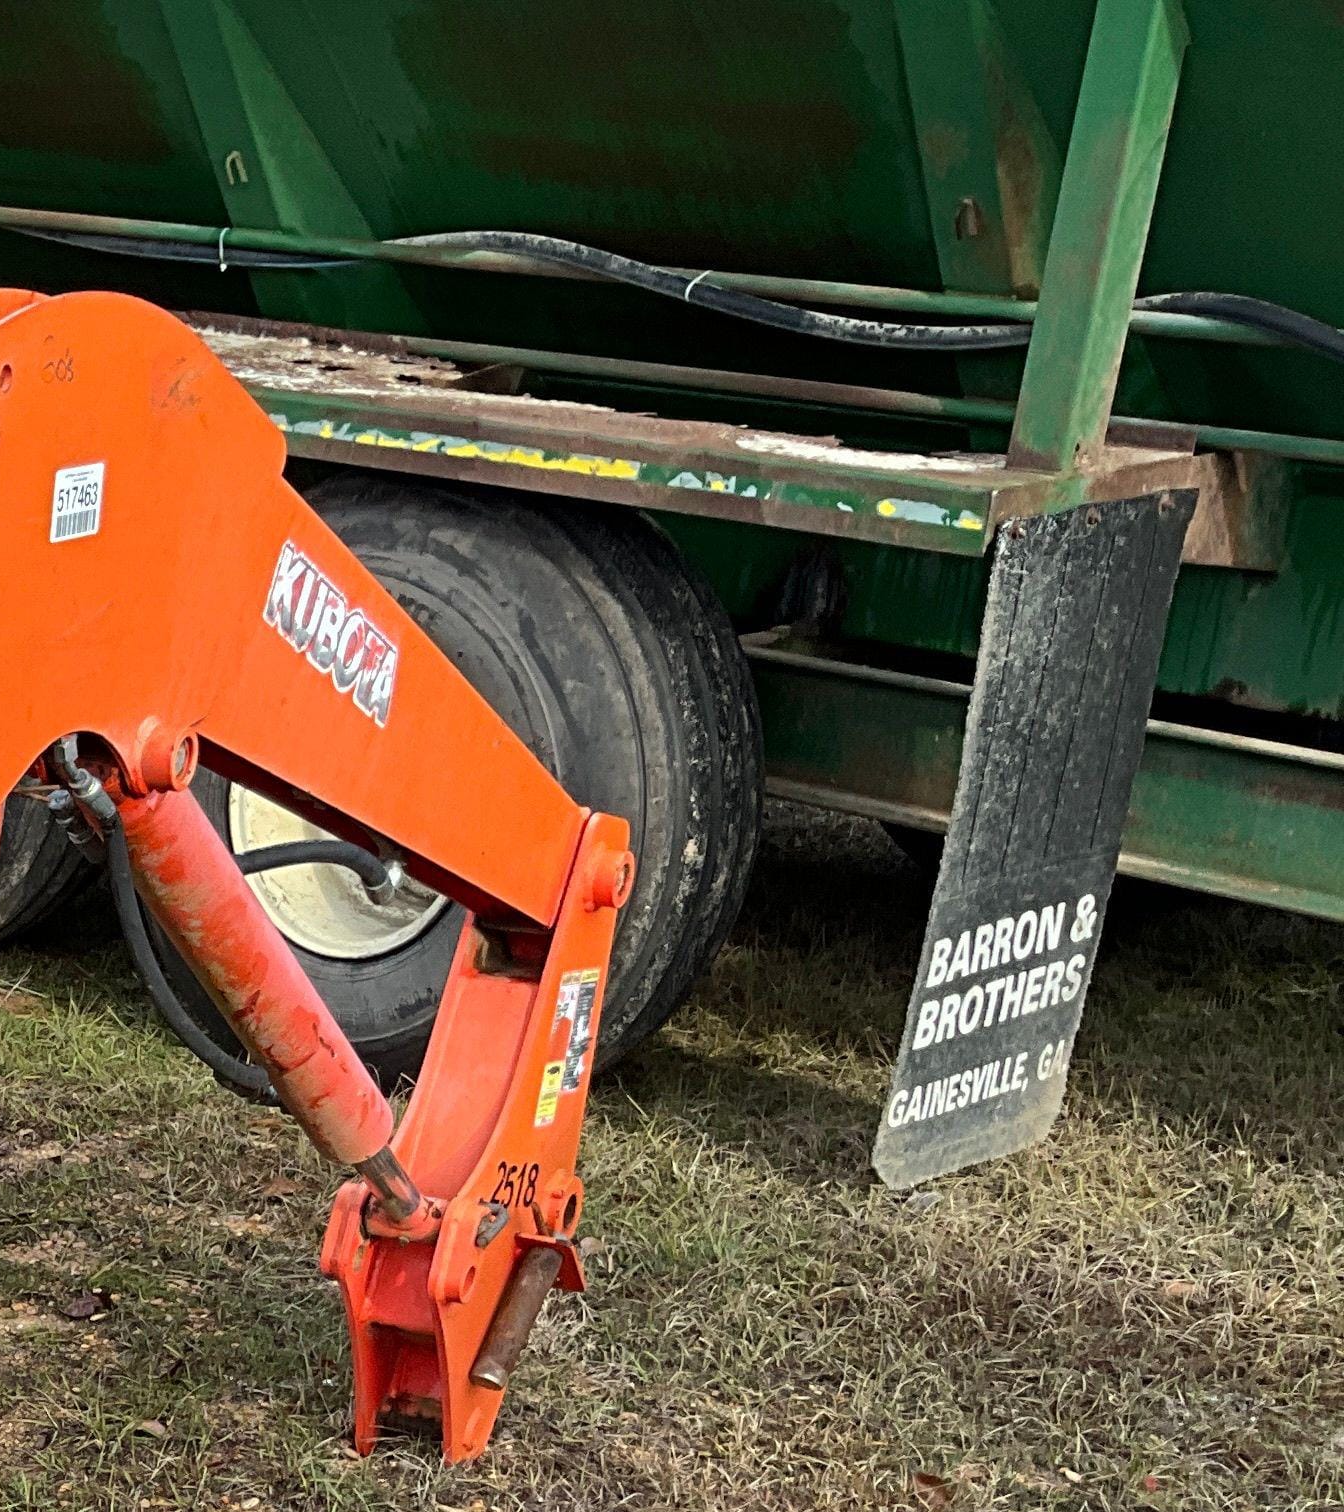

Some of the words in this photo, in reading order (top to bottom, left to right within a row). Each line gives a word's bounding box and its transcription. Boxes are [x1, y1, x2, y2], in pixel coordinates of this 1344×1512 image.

[57, 482, 98, 512] 517463
[264, 541, 398, 726] KUBOTA
[926, 902, 1066, 988] BARRON
[1070, 893, 1097, 942] &
[912, 953, 1086, 1050] BROTHERS
[887, 1052, 1029, 1128] GAINESVILLE,
[490, 1161, 539, 1208] 2518
